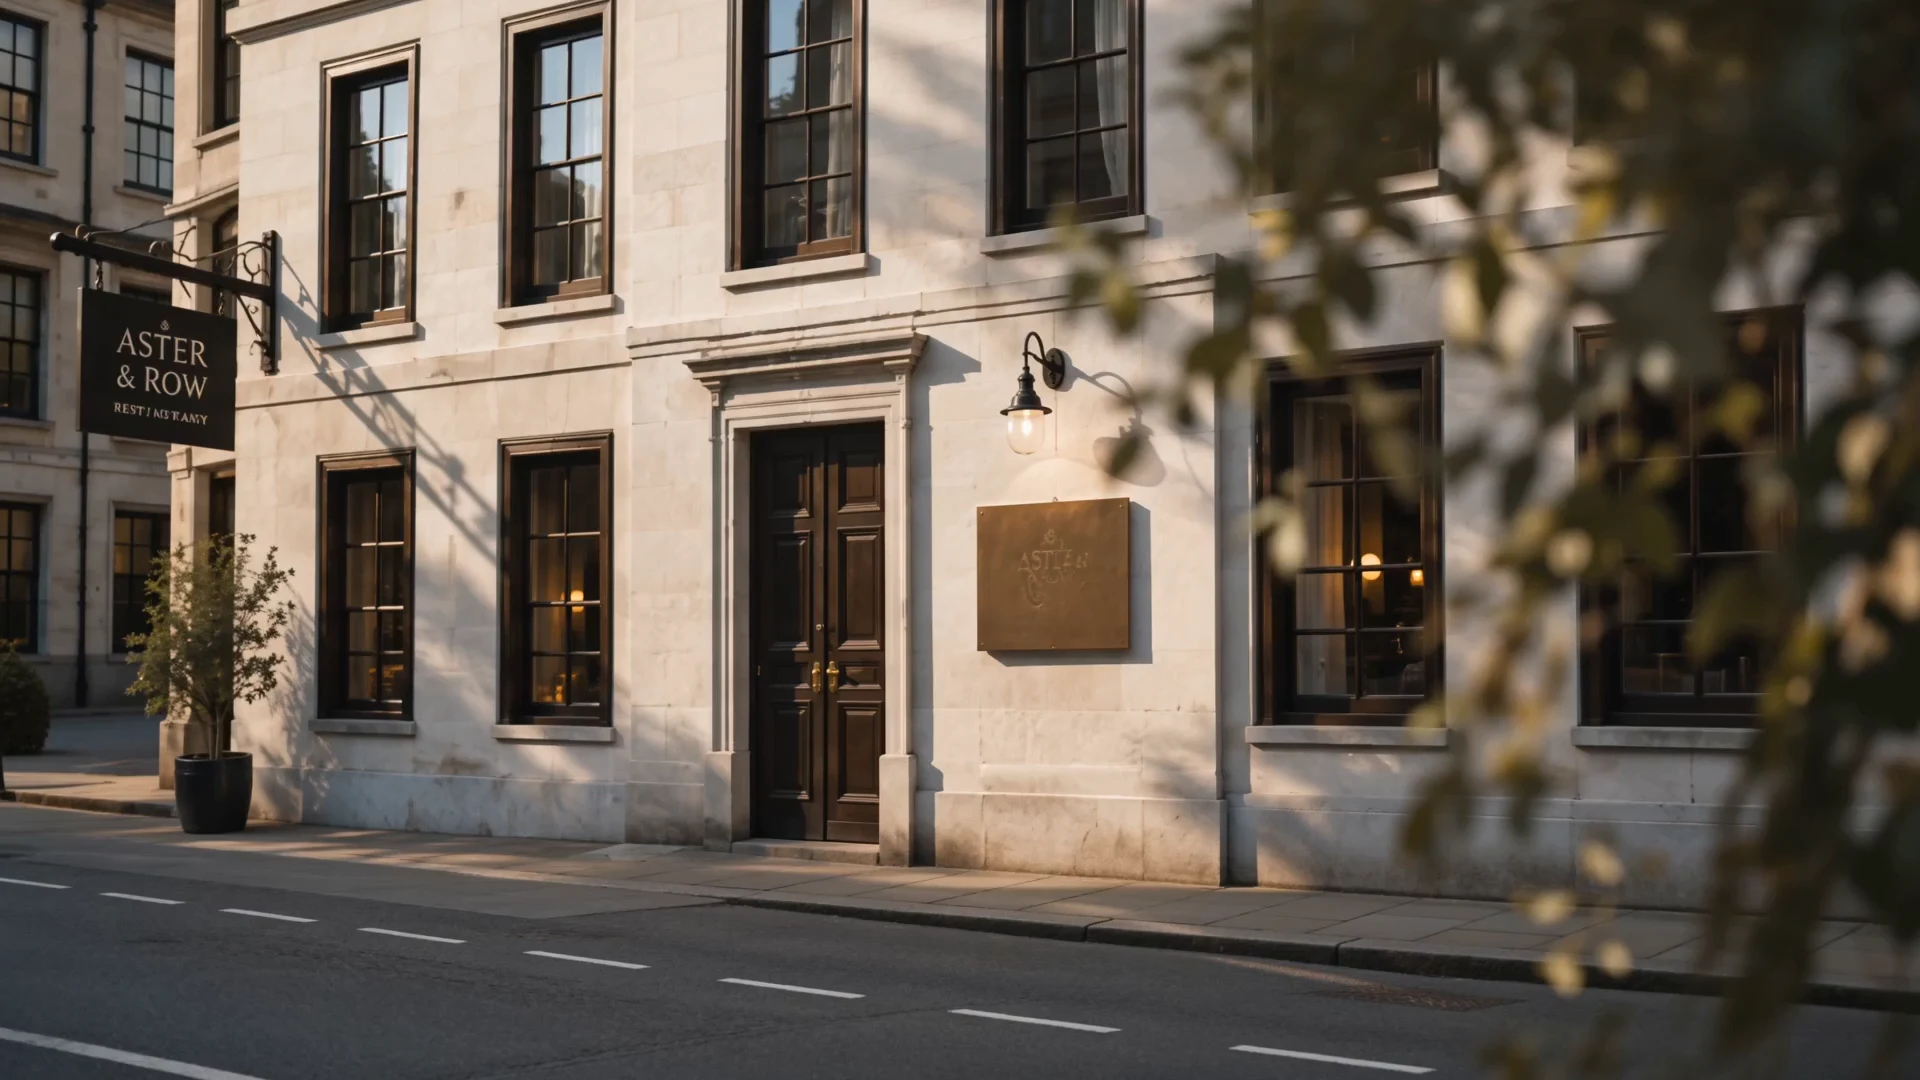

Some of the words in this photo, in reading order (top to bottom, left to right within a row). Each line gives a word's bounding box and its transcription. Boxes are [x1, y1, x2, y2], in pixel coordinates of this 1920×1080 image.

[116, 327, 208, 368] ASTER
[116, 364, 136, 389] &
[145, 365, 208, 400] ROW
